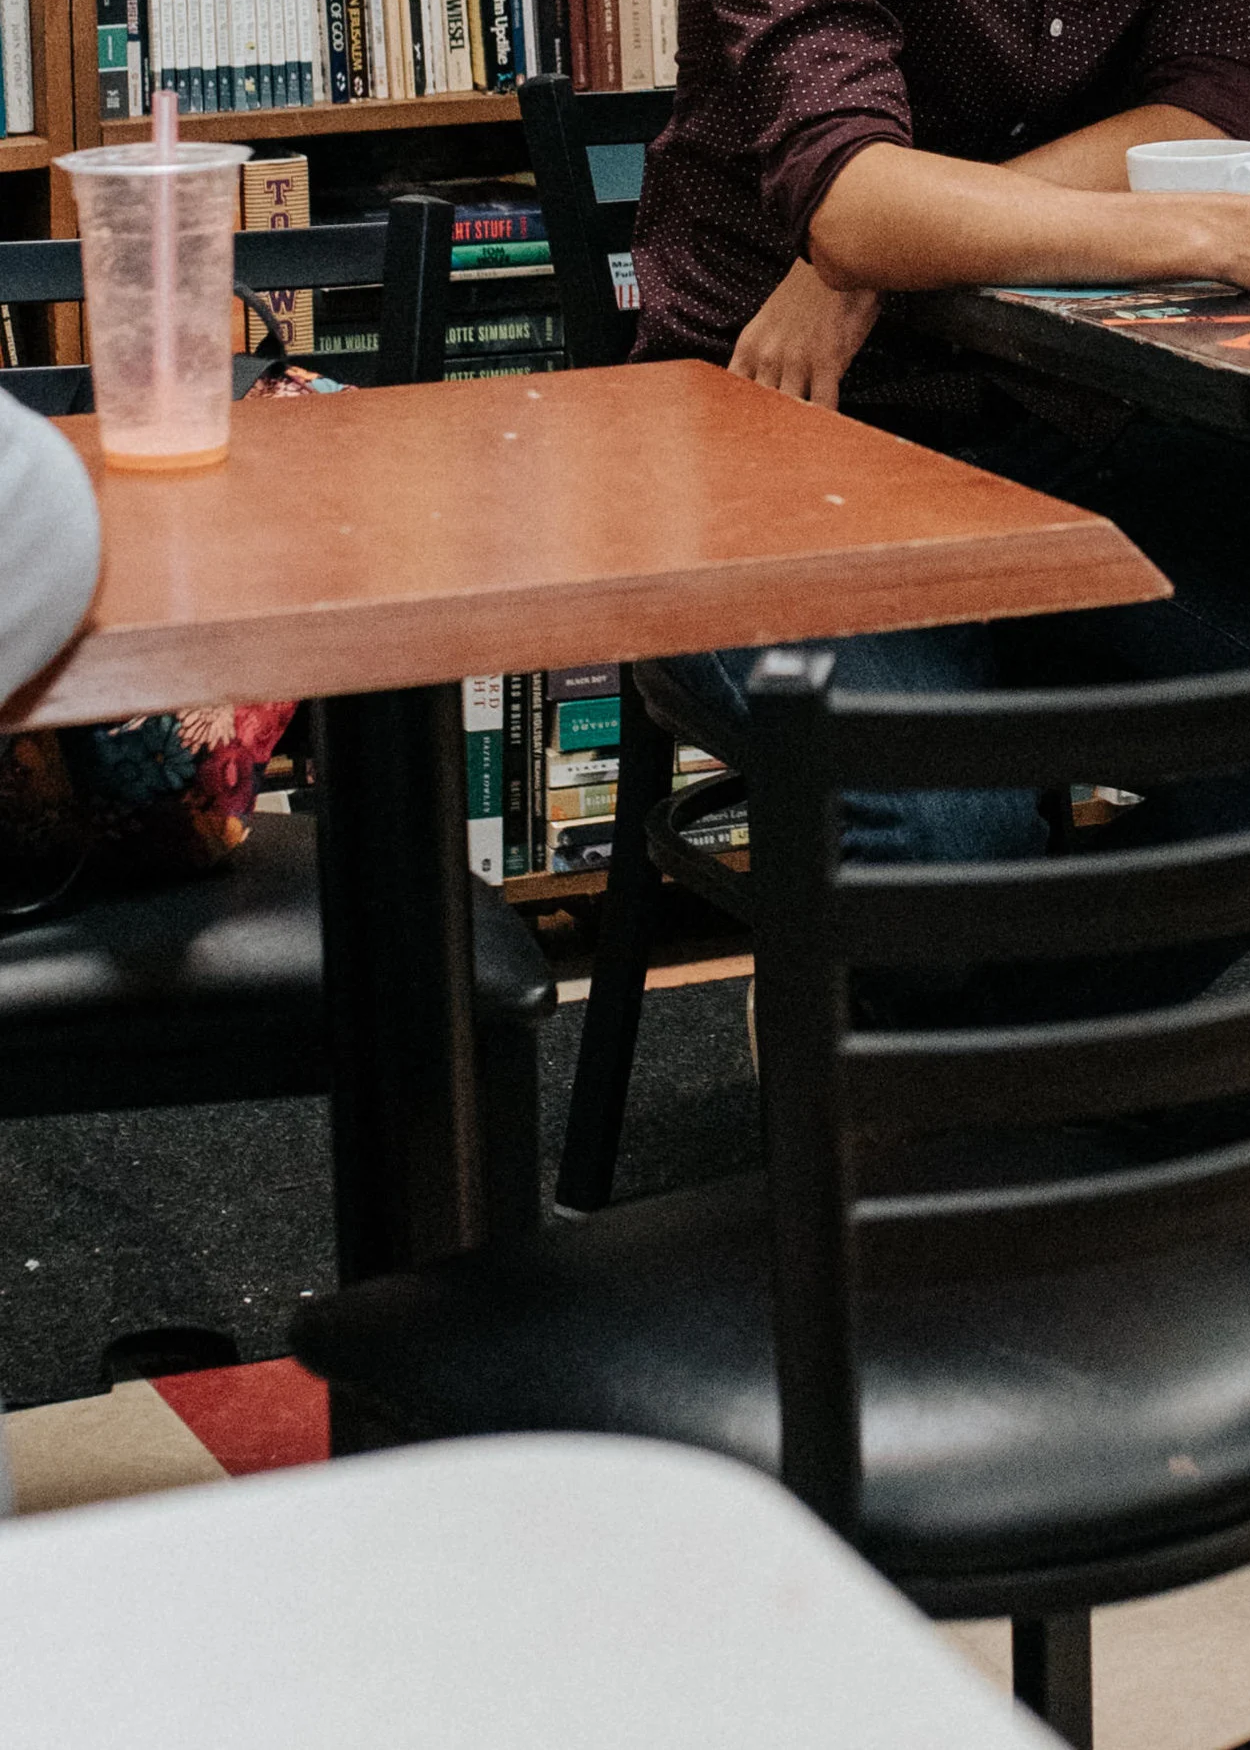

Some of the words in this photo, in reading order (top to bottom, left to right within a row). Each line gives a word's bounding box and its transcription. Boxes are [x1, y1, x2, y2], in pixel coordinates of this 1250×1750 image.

[329, 2, 342, 19] OF
[331, 21, 344, 52] GOD
[347, 7, 362, 72] JERUSALEM
[492, 16, 510, 65] Updike
[474, 218, 514, 239] STUFF
[480, 246, 506, 256] TOM
[318, 335, 342, 352] TOM
[344, 333, 380, 351] WOLFE
[510, 703, 523, 746] WRIGHT
[483, 736, 492, 771] HAZEL
[483, 773, 492, 815] ROWLEY
